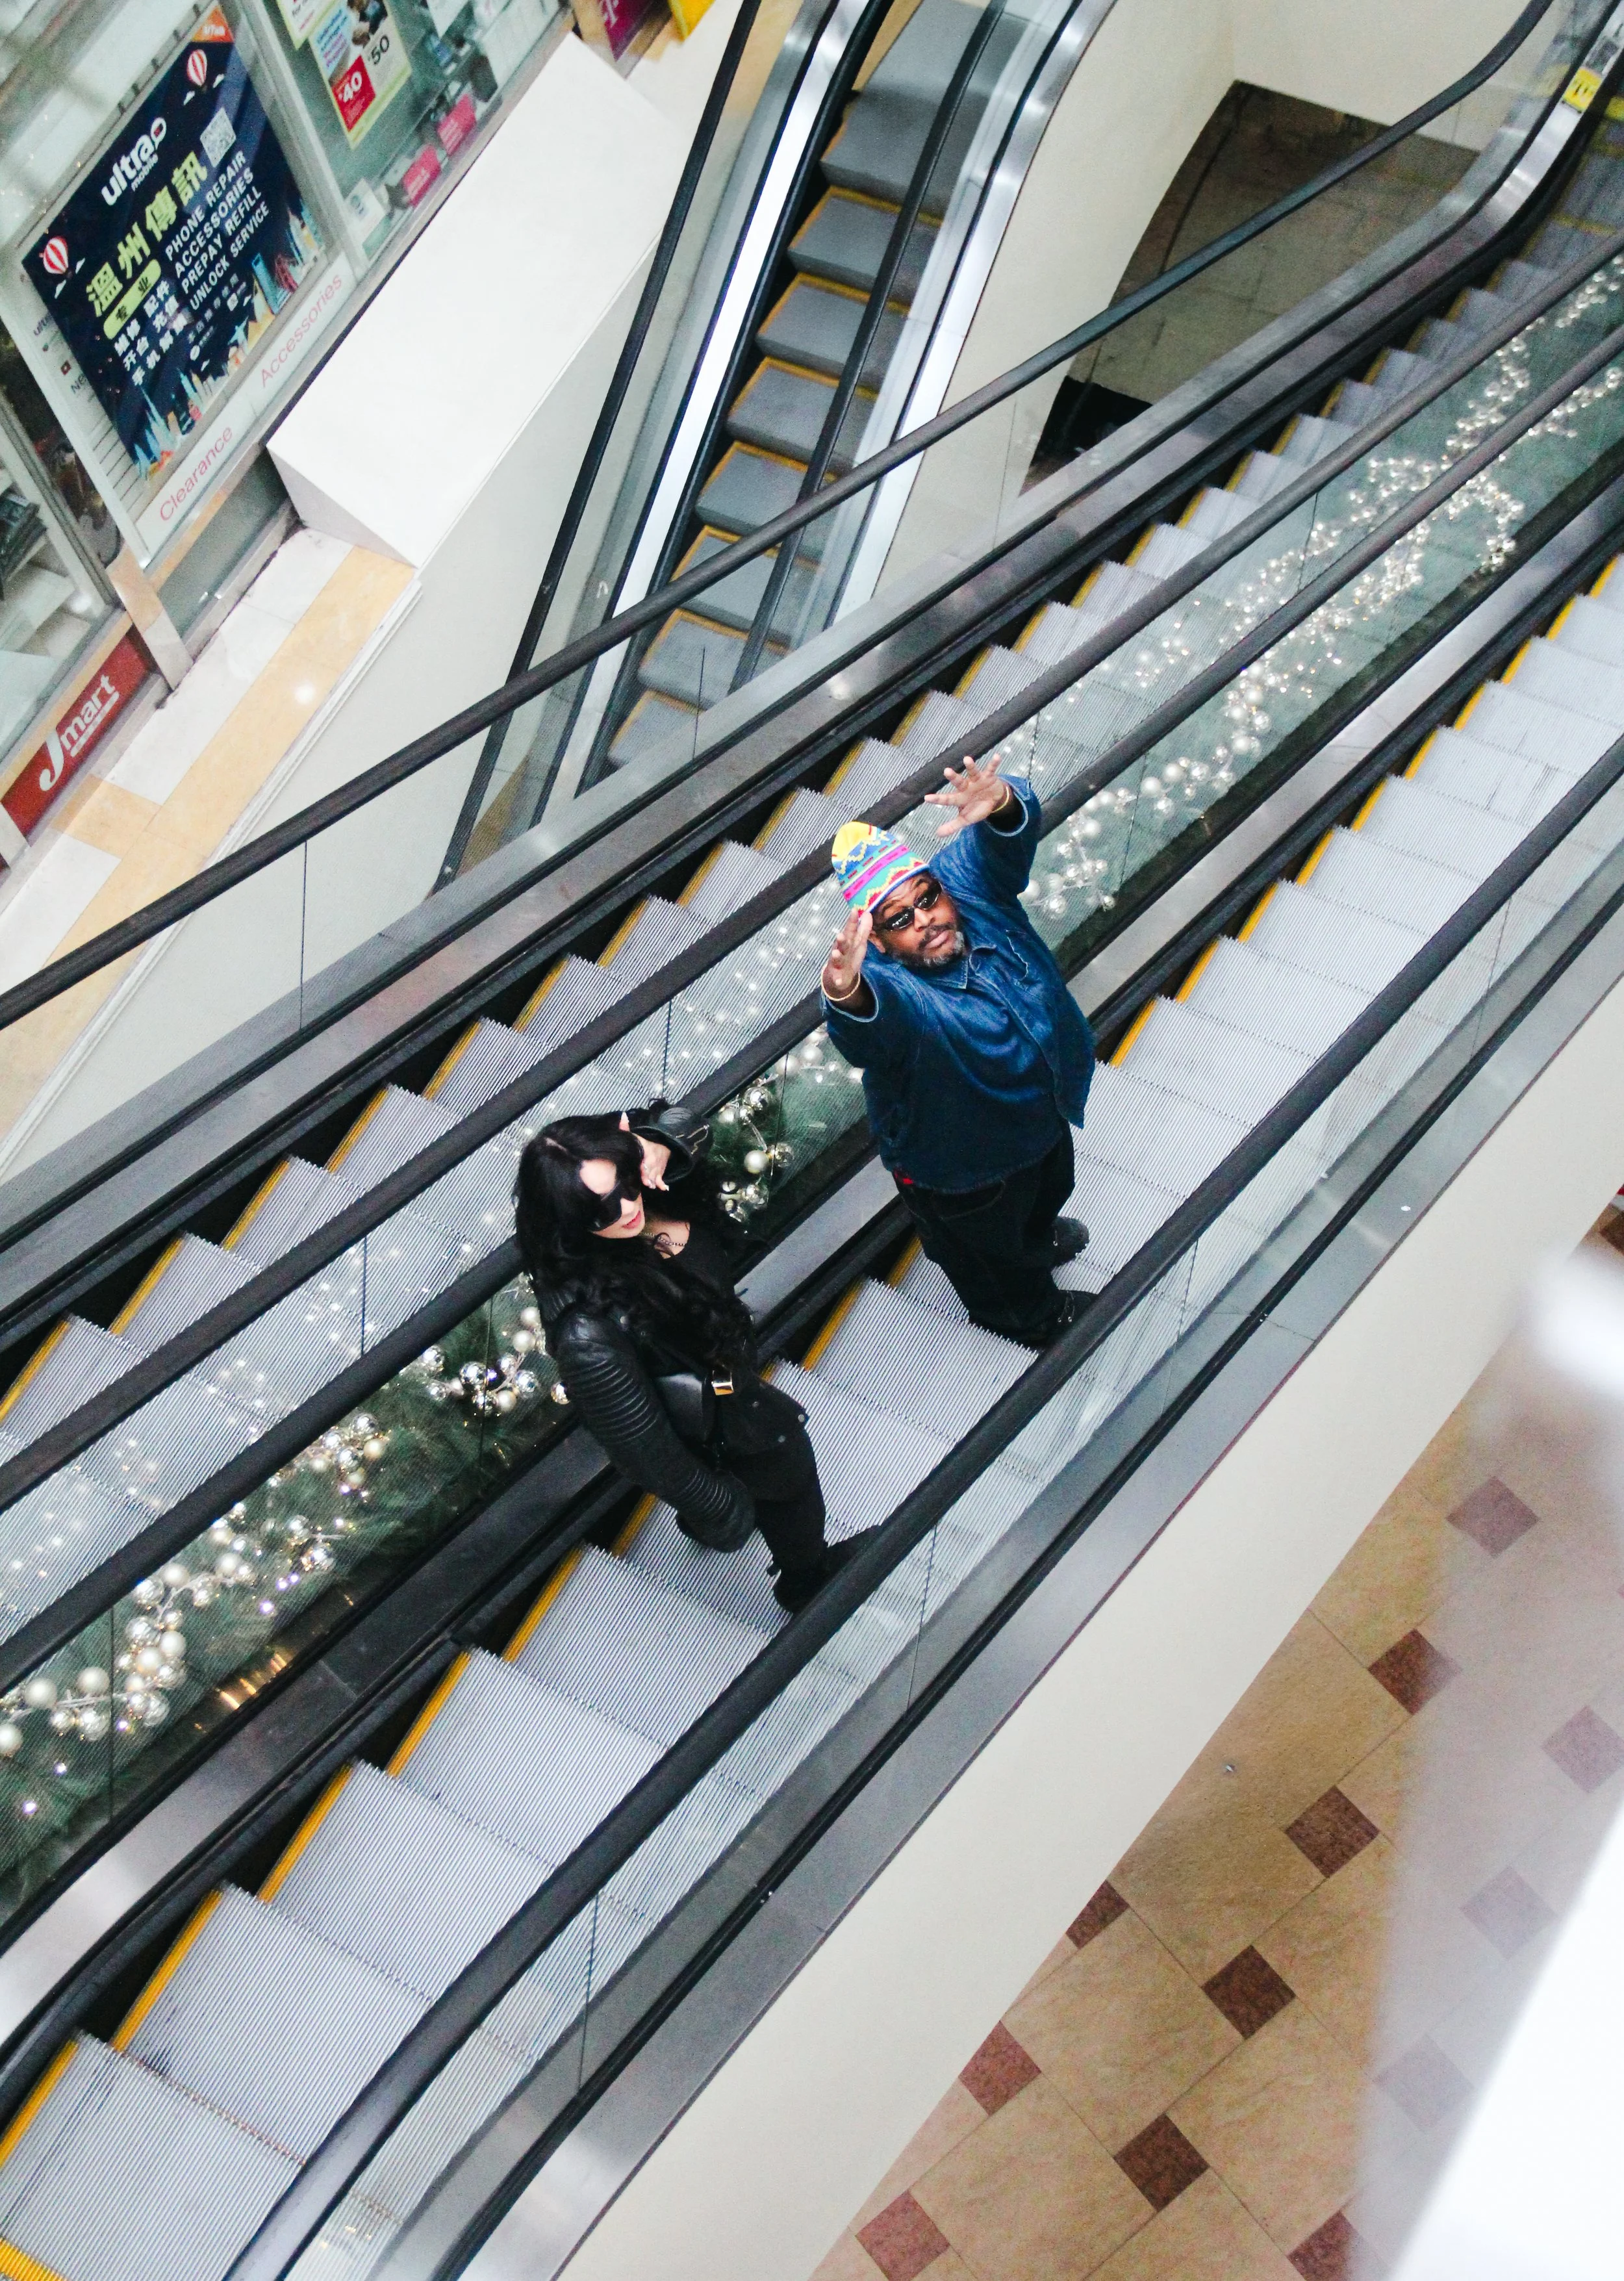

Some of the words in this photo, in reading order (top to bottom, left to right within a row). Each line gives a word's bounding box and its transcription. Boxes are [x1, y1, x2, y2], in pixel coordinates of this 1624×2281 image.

[101, 134, 155, 205] ultra
[166, 205, 205, 261] PHONE
[205, 151, 246, 207] REPAIR
[175, 167, 254, 278] ACCESSORIES
[181, 233, 223, 294] PREPAY
[225, 186, 262, 236] REFILL
[190, 254, 230, 311] UNLOCK
[230, 201, 270, 257] SERVICE
[261, 275, 342, 388] Accessories
[159, 426, 233, 522] Clearance
[40, 674, 116, 791] Jmart
